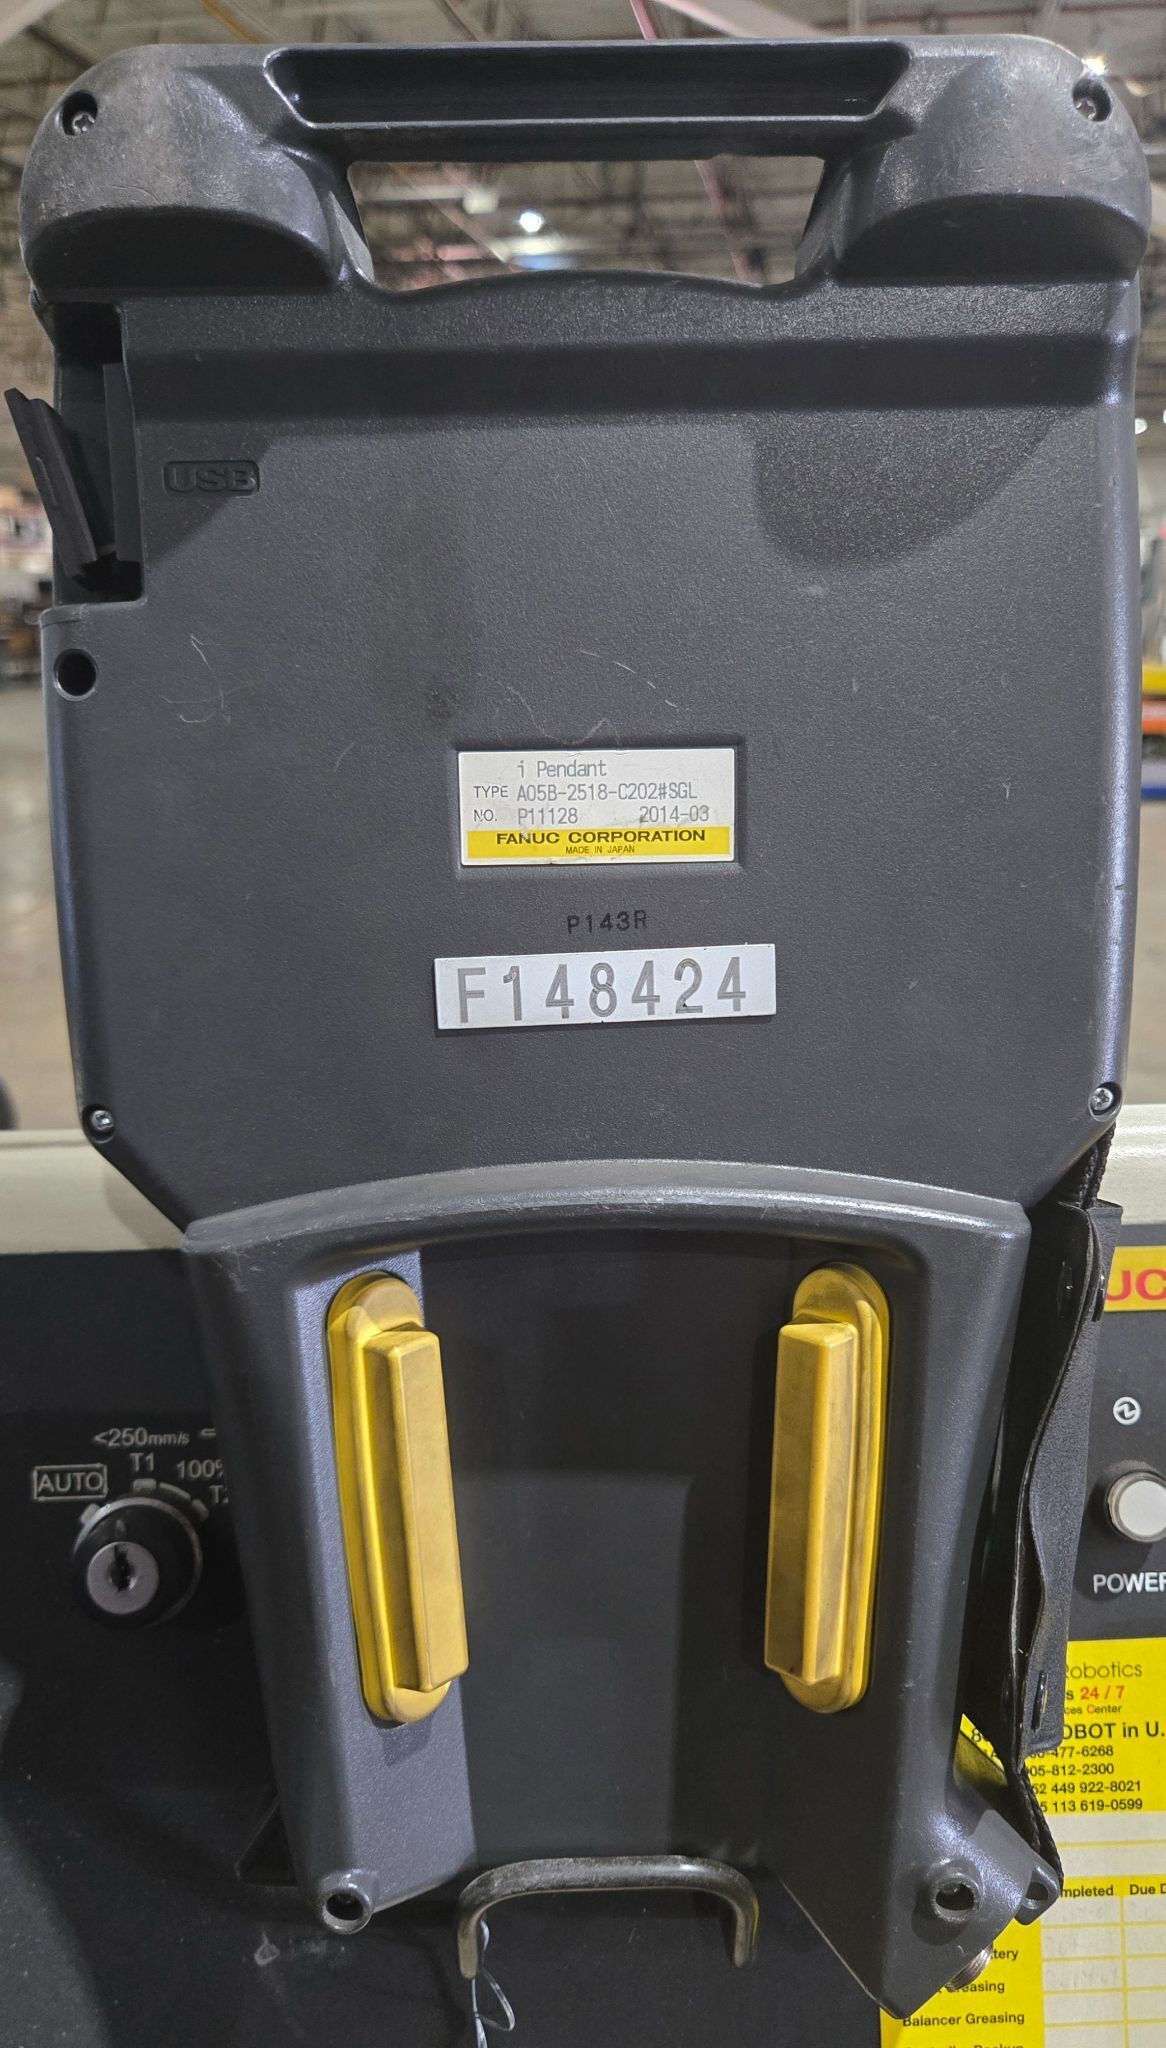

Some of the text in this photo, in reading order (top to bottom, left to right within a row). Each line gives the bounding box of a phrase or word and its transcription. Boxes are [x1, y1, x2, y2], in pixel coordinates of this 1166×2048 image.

[168, 465, 257, 492] USB
[537, 760, 607, 778] Pendant
[473, 782, 698, 802] TYPE A05B-2518-C202#SGL
[473, 805, 710, 825] NO. P11128 2014-03
[496, 829, 706, 845] FANUC CORPORATION
[565, 845, 635, 855] MADE IN JAPAN
[566, 909, 648, 935] P143R
[457, 956, 747, 1024] F148424
[129, 1452, 155, 1472] T1
[37, 1471, 105, 1492] AUTO
[1065, 1661, 1142, 1679] obotics
[1080, 1685, 1099, 1700] 24
[1116, 1685, 1125, 1699] 7
[1086, 1703, 1122, 1714] Center
[1063, 1723, 1116, 1740] OBOT
[1122, 1722, 1139, 1737] in
[1028, 1763, 1115, 1776] 05-812-2300
[1051, 1783, 1076, 1794] 449
[1079, 1780, 1141, 1793] 922-8021
[1053, 1802, 1076, 1812] 113
[1080, 1799, 1143, 1811] 619-0599
[1061, 1885, 1114, 1898] mpleted
[1130, 1884, 1156, 1895] Due
[965, 2012, 1025, 2024] Greasing
